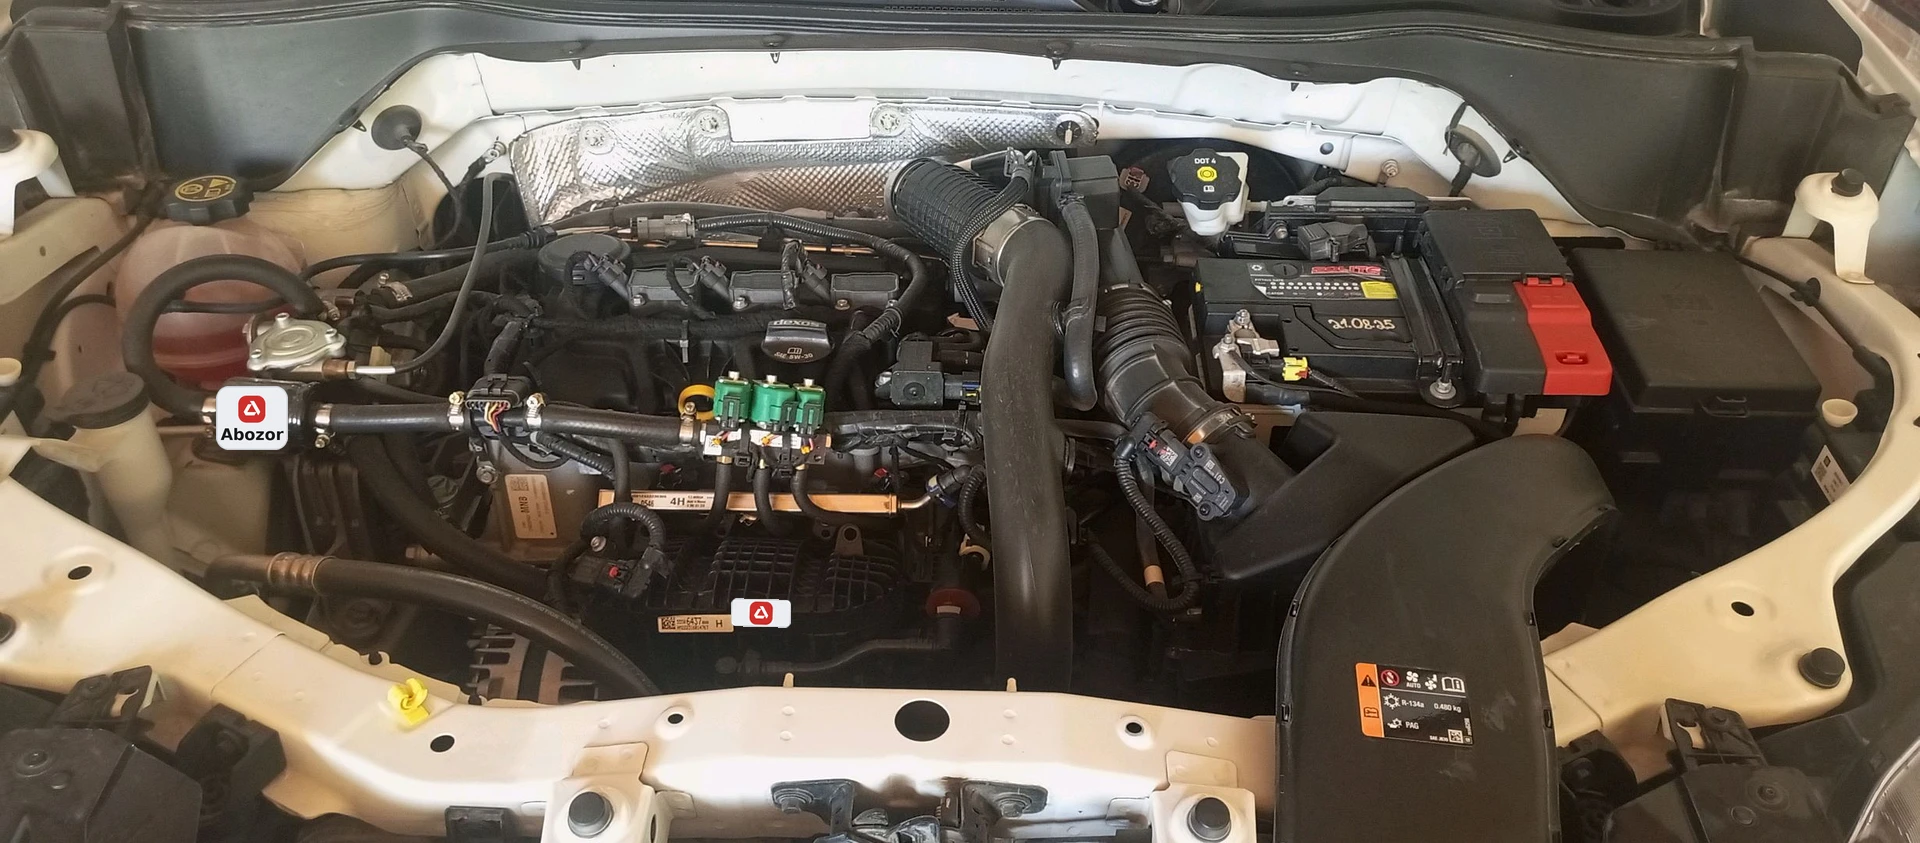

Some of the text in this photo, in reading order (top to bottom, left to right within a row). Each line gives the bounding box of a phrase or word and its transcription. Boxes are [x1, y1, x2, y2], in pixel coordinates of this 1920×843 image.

[773, 319, 820, 328] dexos
[1328, 317, 1396, 330] 21.08.25
[518, 496, 530, 513] MNB
[670, 497, 685, 506] 4H
[717, 619, 723, 628] H
[1401, 699, 1425, 708] R-134a
[1433, 703, 1462, 713] 0.480 kg
[1405, 721, 1420, 730] PAG
